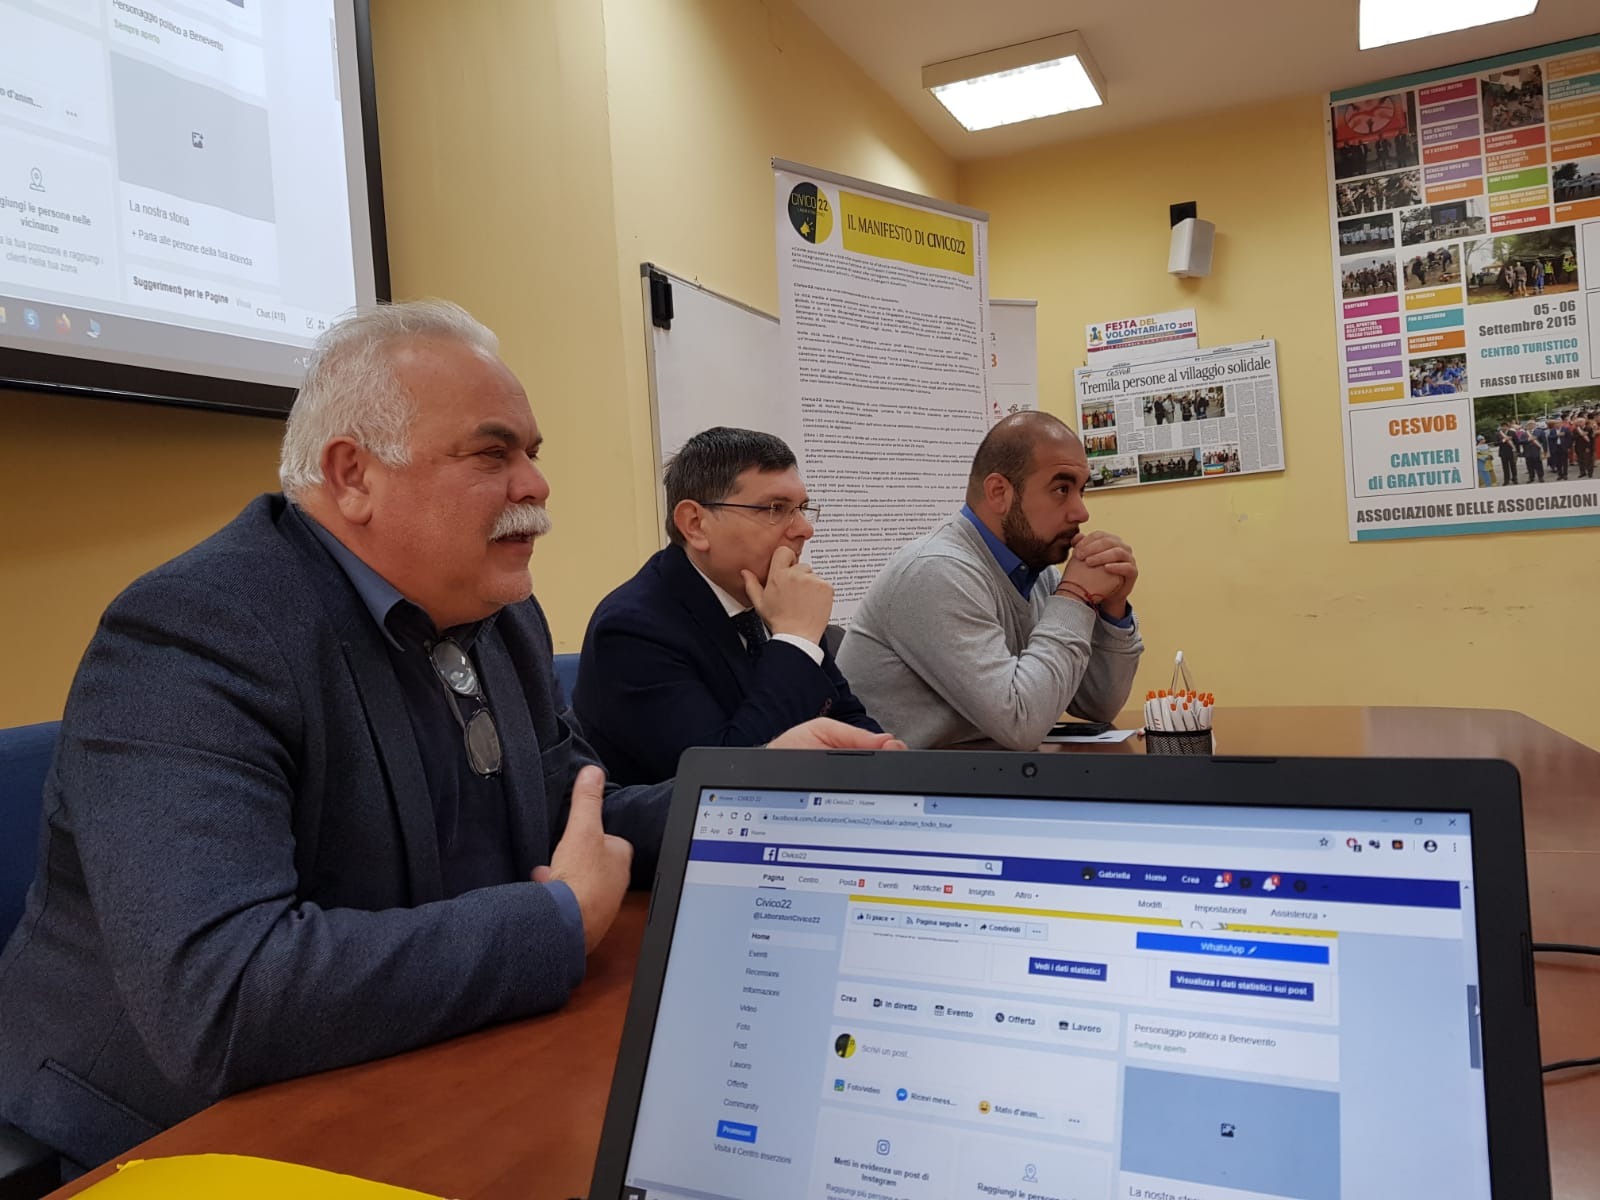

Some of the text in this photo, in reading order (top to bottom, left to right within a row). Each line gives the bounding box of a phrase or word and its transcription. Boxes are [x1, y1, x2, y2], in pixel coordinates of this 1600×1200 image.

[791, 193, 828, 211] CIVICO 22
[38, 207, 71, 221] persone
[72, 214, 91, 225] nelle
[129, 200, 140, 213] La
[142, 203, 168, 219] nostra
[20, 216, 60, 234] vicinanze
[847, 213, 966, 255] IL MANIFESTO DI CIVICO22
[133, 275, 182, 295] Suggerimenti
[183, 286, 195, 299] per
[196, 288, 204, 300] le
[1533, 300, 1576, 317] 05 06
[1105, 318, 1157, 331] FESTA DEL
[1105, 322, 1177, 339] VOLONTARIATO
[1479, 315, 1576, 338] Settembre 2015
[1481, 337, 1578, 359] CENTRO TURISTICO
[1545, 352, 1579, 366] S.VITO
[1081, 378, 1120, 395] Tremila
[1122, 373, 1166, 392] persone
[1168, 368, 1178, 382] al
[1180, 363, 1225, 381] villaggio
[1227, 356, 1271, 375] solidale
[1480, 369, 1580, 388] FRASSO TELESINO BN
[1389, 414, 1458, 436] CESVOB
[1390, 448, 1460, 468] CANTIERI
[1368, 467, 1462, 490] di GRATUITÀ
[1357, 493, 1598, 523] ASSOCIAZIONE DELLE ASSOCIAZIONI
[763, 873, 785, 882] Pagina
[798, 876, 819, 884] Centro
[1145, 873, 1168, 882] Home
[1181, 875, 1200, 884] Crea
[878, 881, 898, 890] Eventi
[969, 887, 995, 897] Insights
[1014, 891, 1032, 899] Altro
[755, 897, 793, 909] Civico22
[1194, 904, 1247, 915] Impostazioni
[1270, 908, 1318, 920] Assistenza
[916, 918, 937, 927] Pagina
[989, 924, 1021, 933] Condividi
[752, 932, 770, 941] Home
[1200, 941, 1245, 954] WhatsApp
[1034, 962, 1050, 971] Vedi
[1055, 964, 1069, 973] dati
[1070, 965, 1101, 976] statistici
[1176, 975, 1215, 987] Visualizza
[1221, 979, 1236, 988] dati
[1238, 981, 1272, 992] statistici
[1273, 985, 1286, 993] sui
[1287, 986, 1307, 996] post
[840, 994, 857, 1004] Crea
[885, 1000, 917, 1012] In diretta
[946, 1008, 973, 1018] Evento
[1008, 1014, 1036, 1025] Offerta
[736, 1022, 750, 1031] Foto
[1072, 1022, 1101, 1033] Lavoro
[1134, 1023, 1186, 1038] Personaggio
[1188, 1030, 1218, 1042] politico
[1228, 1034, 1276, 1048] Benevento
[733, 1041, 748, 1050] Post
[862, 1044, 881, 1055] Scrivi
[911, 1092, 931, 1102] Ricevi
[723, 1098, 759, 1112] Community
[994, 1105, 1012, 1114] Stato
[737, 1147, 759, 1158] Centro
[834, 1156, 929, 1181] Metti in evidenza un post di
[861, 1174, 897, 1187] Instagram
[977, 1182, 1017, 1198] Raggiungi
[1019, 1190, 1026, 1199] le
[1129, 1186, 1142, 1197] La
